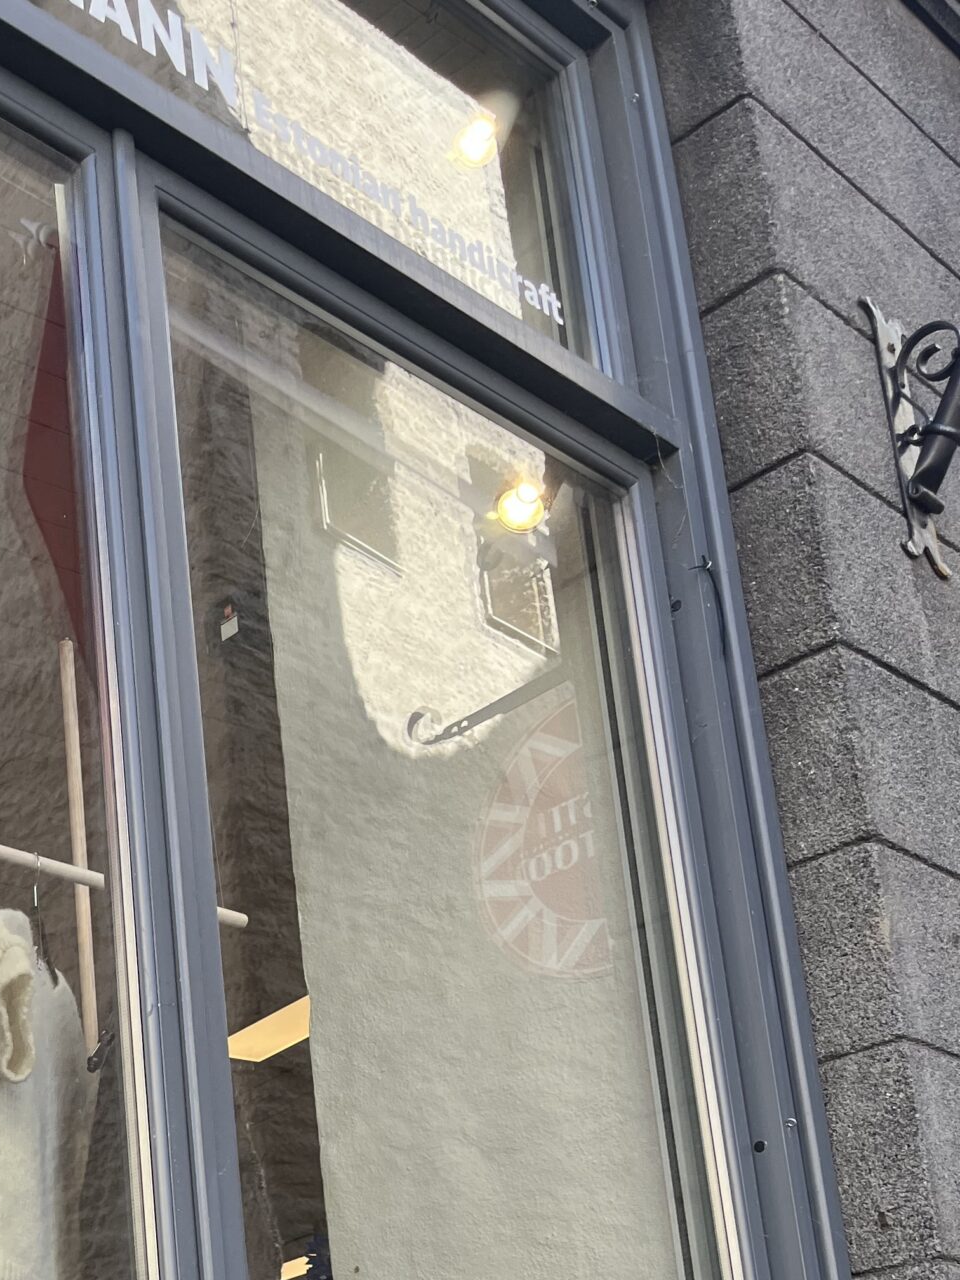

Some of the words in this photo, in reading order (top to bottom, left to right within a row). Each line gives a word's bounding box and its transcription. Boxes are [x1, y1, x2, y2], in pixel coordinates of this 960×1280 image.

[68, 0, 239, 109] ANN
[251, 86, 403, 220] Estonian
[408, 192, 565, 326] handicraft
